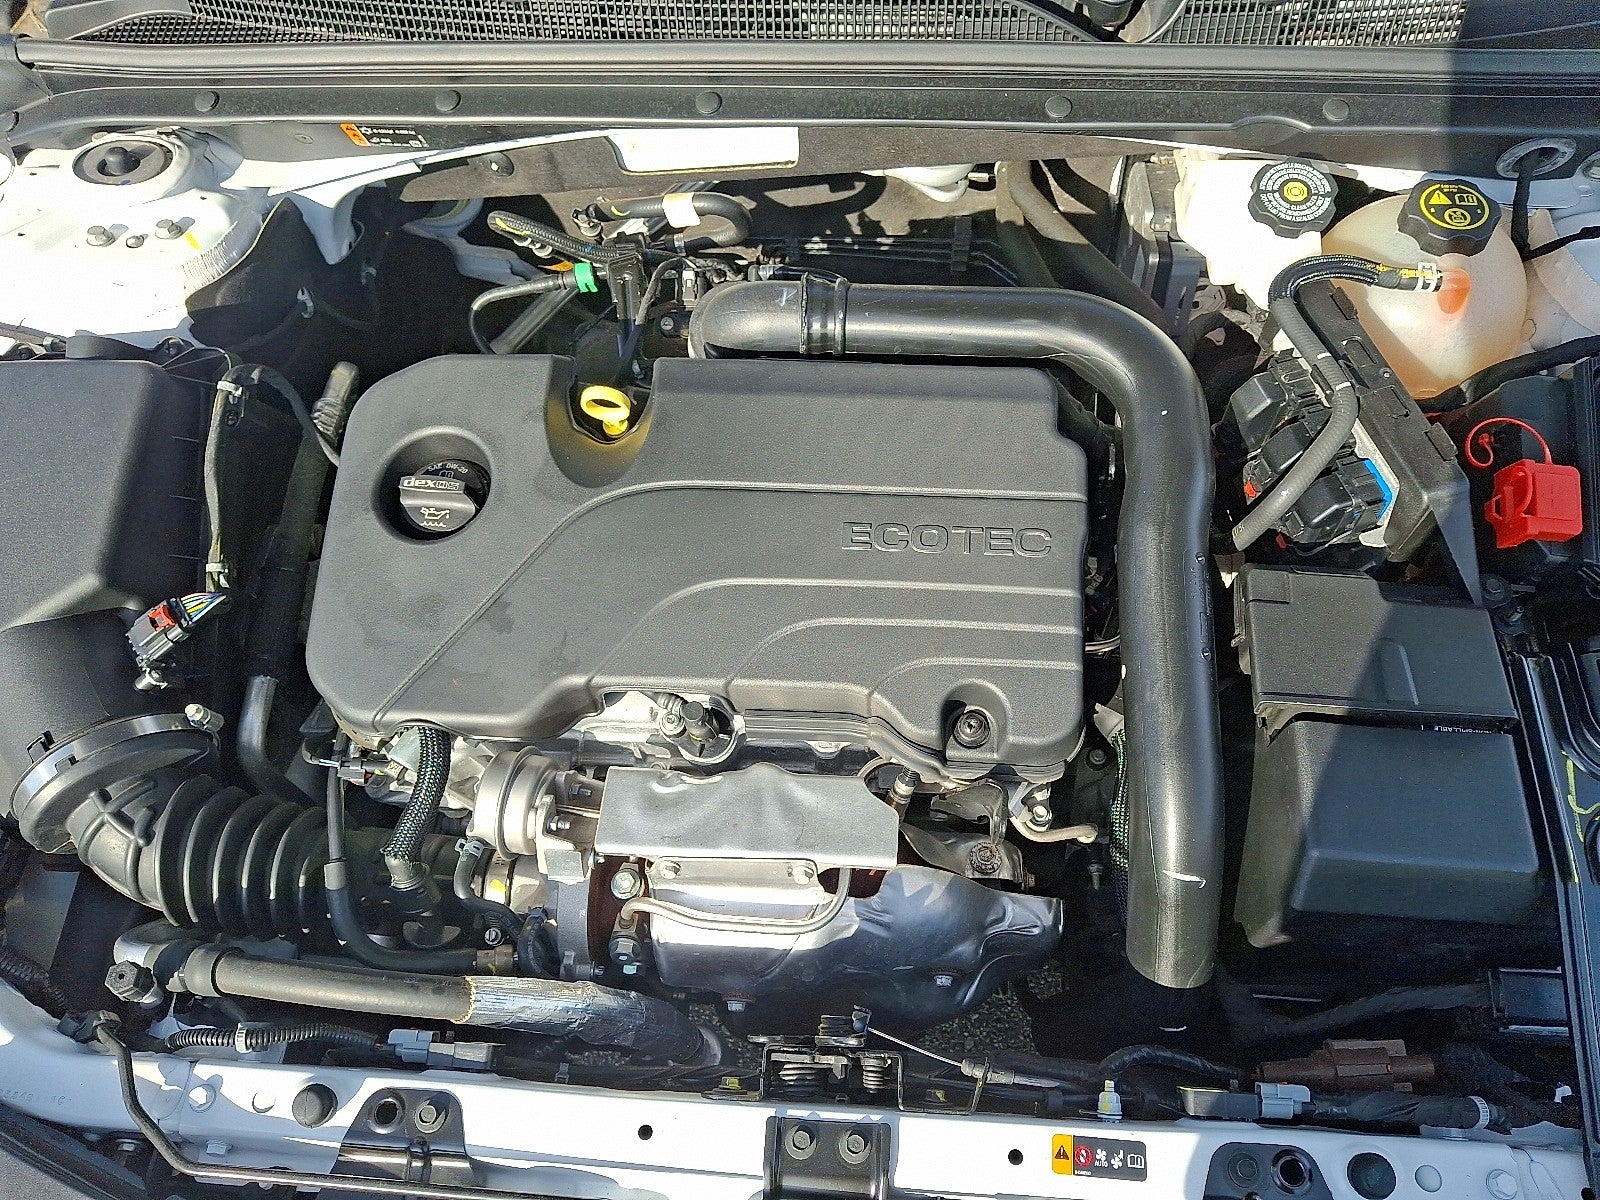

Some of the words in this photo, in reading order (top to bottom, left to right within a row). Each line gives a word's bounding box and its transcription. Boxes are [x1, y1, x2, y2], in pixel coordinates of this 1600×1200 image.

[427, 462, 443, 471] SAE
[446, 462, 469, 474] 0W-20
[403, 477, 460, 490] dexos
[841, 521, 1052, 558] ECOTEC
[1094, 1160, 1109, 1168] AUTO
